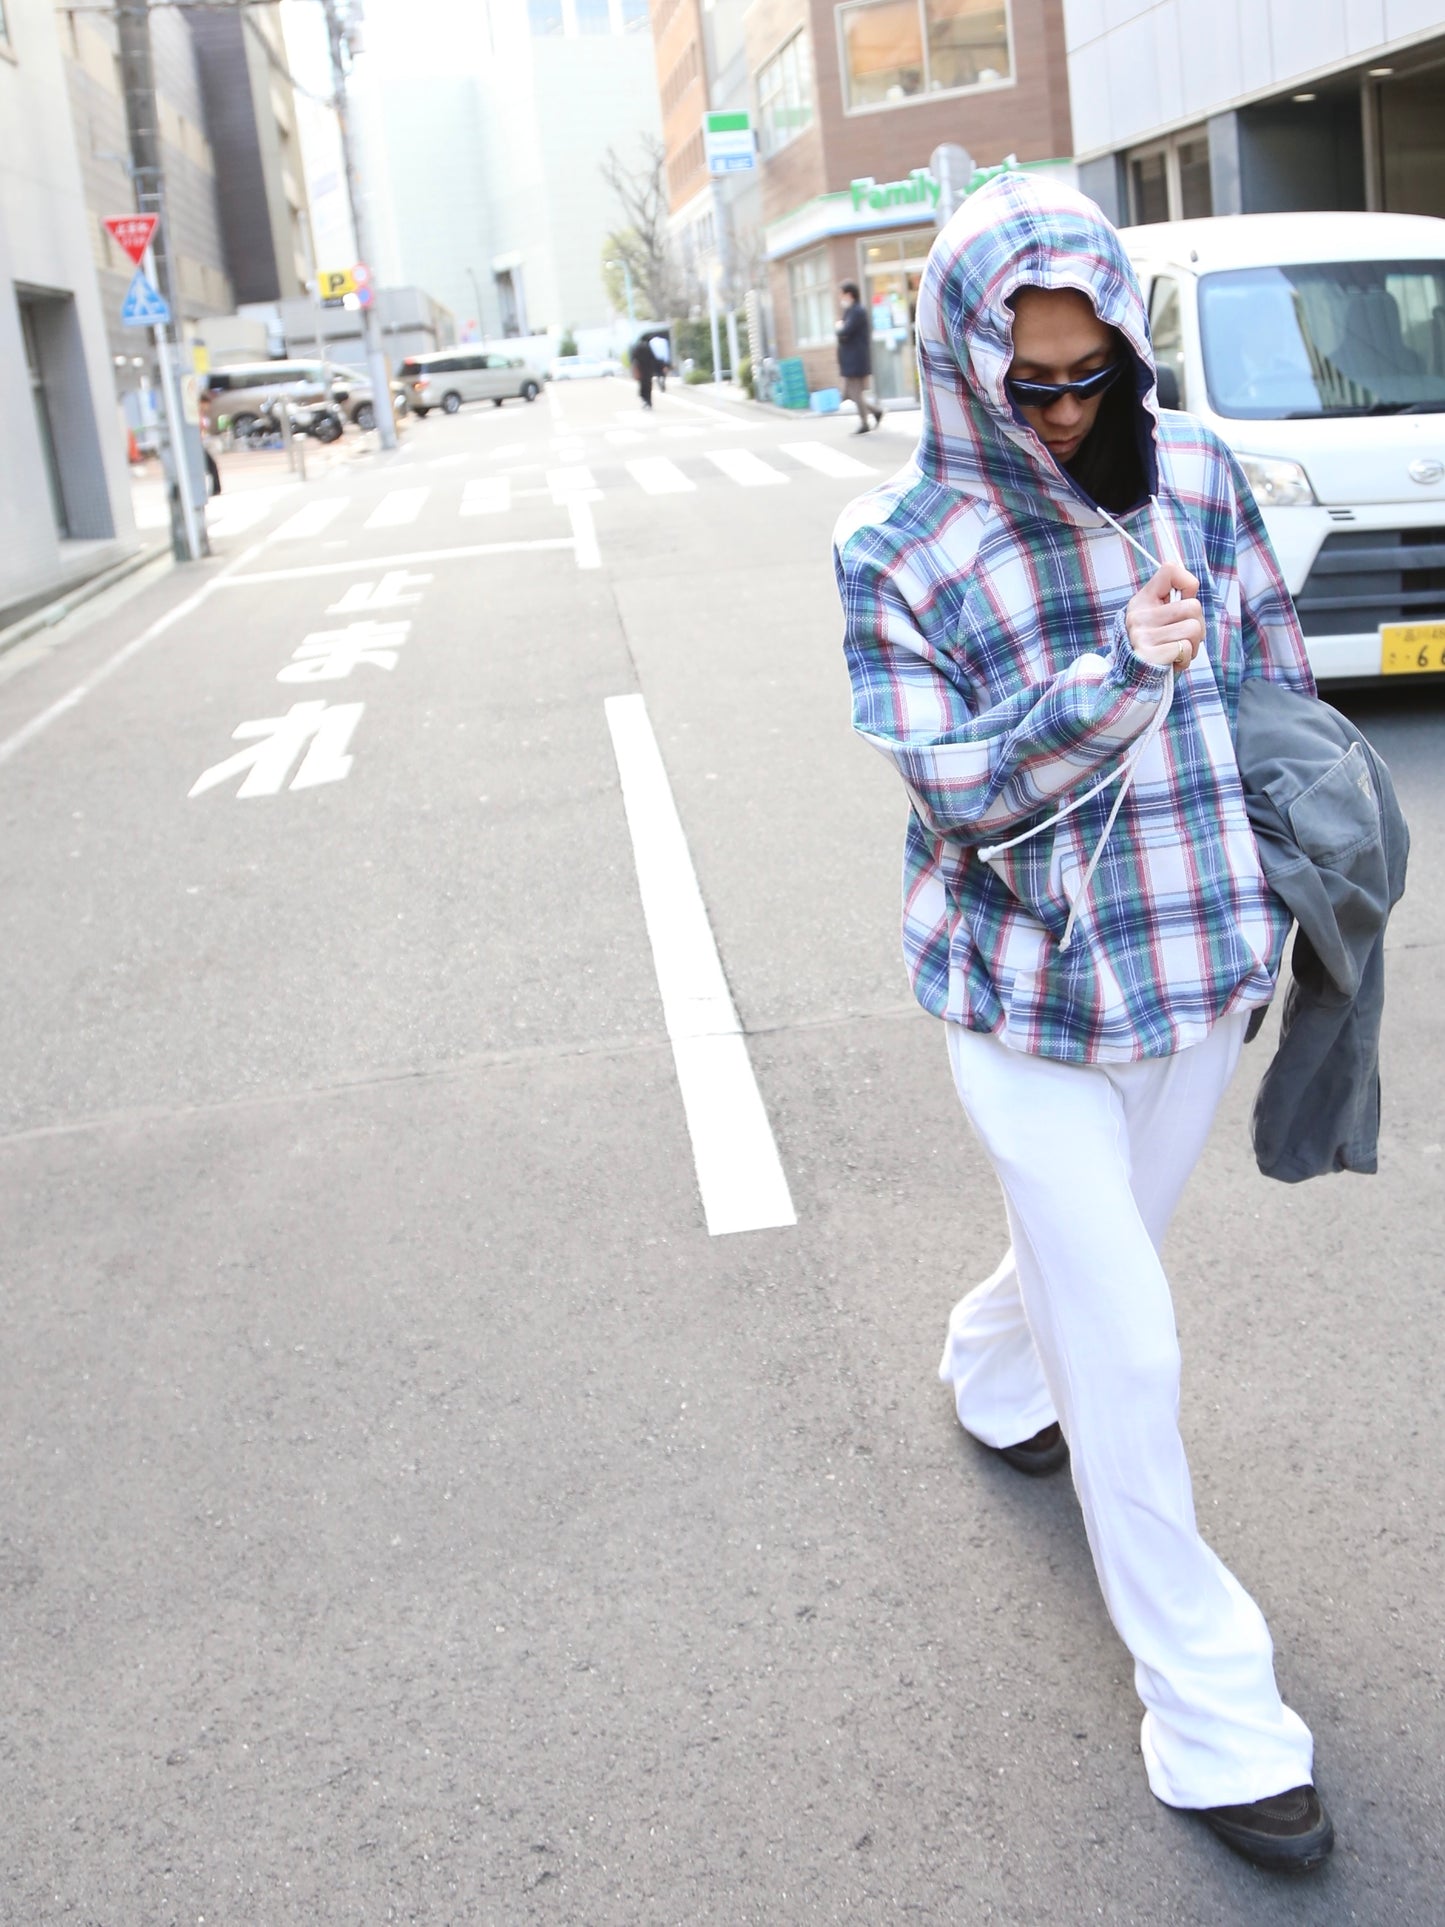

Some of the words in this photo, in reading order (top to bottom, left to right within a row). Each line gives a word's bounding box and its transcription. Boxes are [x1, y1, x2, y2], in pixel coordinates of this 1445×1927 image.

[851, 154, 1015, 212] Familya
[329, 273, 345, 292] P
[187, 569, 434, 799] 止まれ
